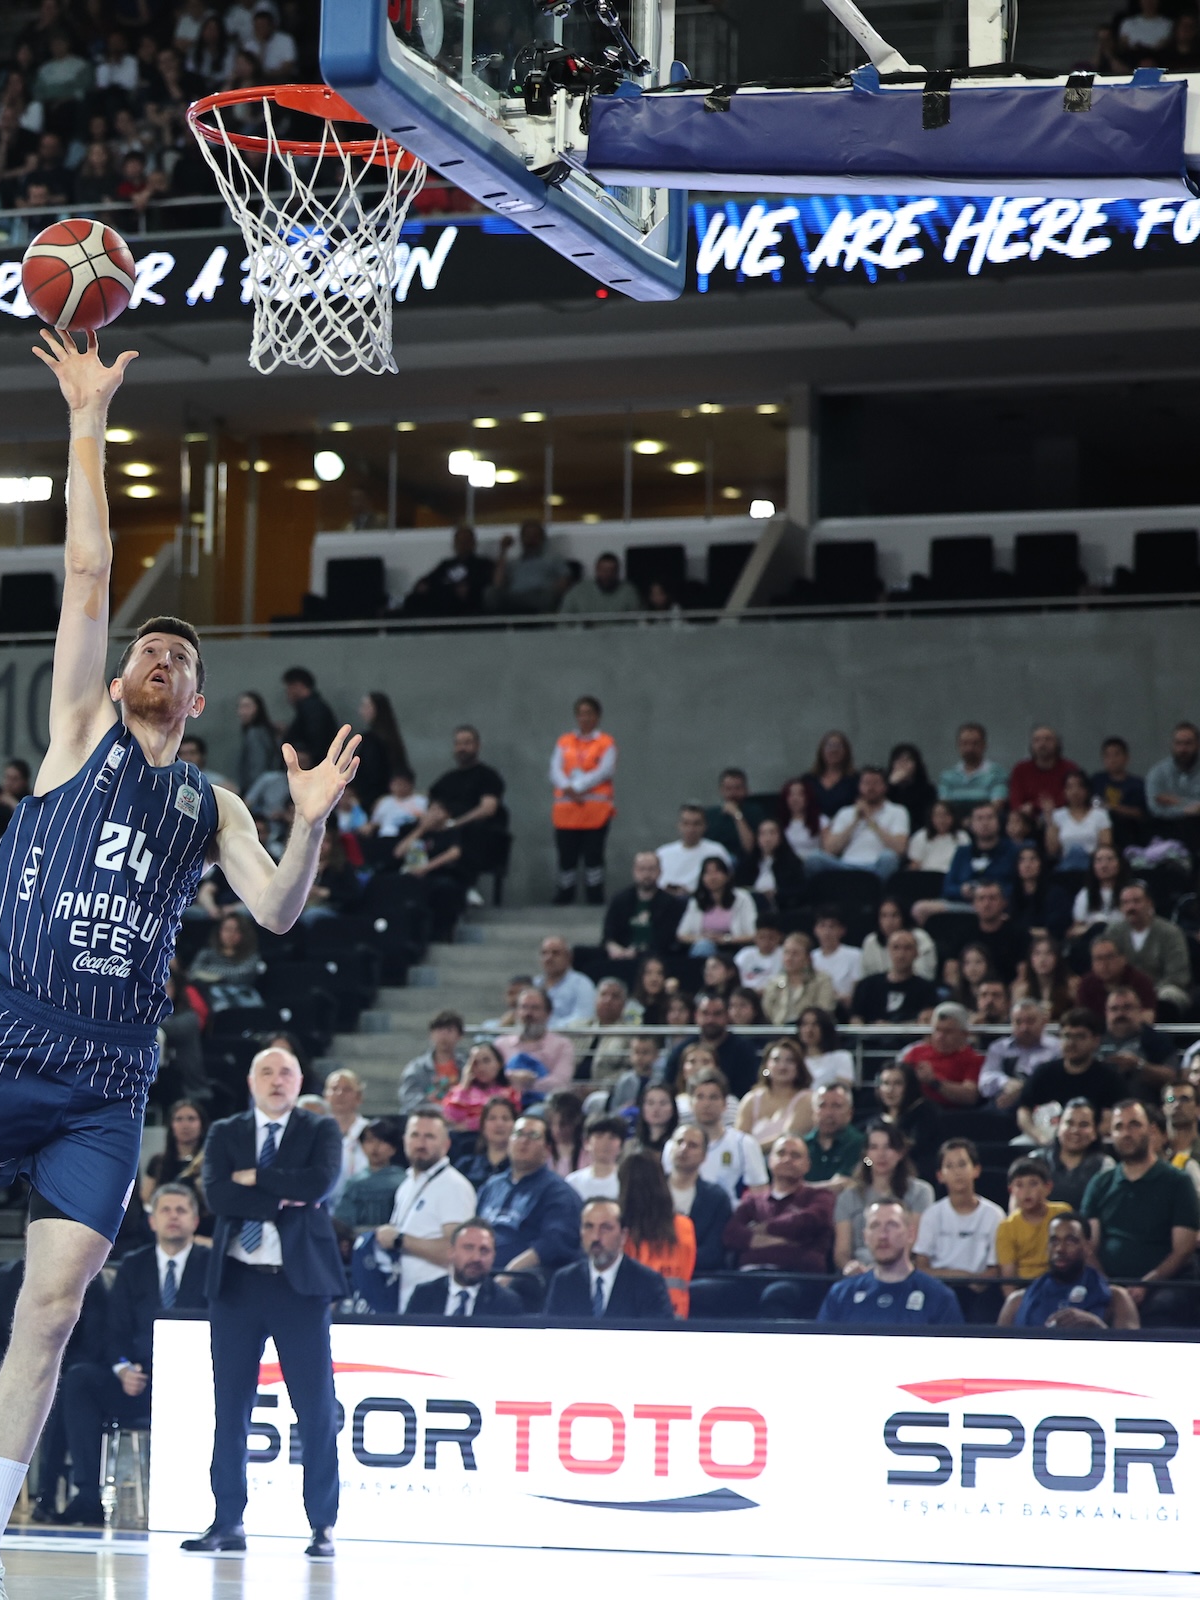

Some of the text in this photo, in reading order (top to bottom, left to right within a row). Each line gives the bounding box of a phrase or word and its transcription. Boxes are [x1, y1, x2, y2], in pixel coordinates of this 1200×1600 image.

[697, 204, 801, 278] WE
[808, 197, 938, 273] ARE
[943, 196, 1118, 275] HERE
[186, 245, 228, 306] A
[94, 821, 154, 885] 24
[54, 891, 160, 943] ANADOLU
[495, 1400, 768, 1481] TOTO
[884, 1411, 1180, 1495] SPOR
